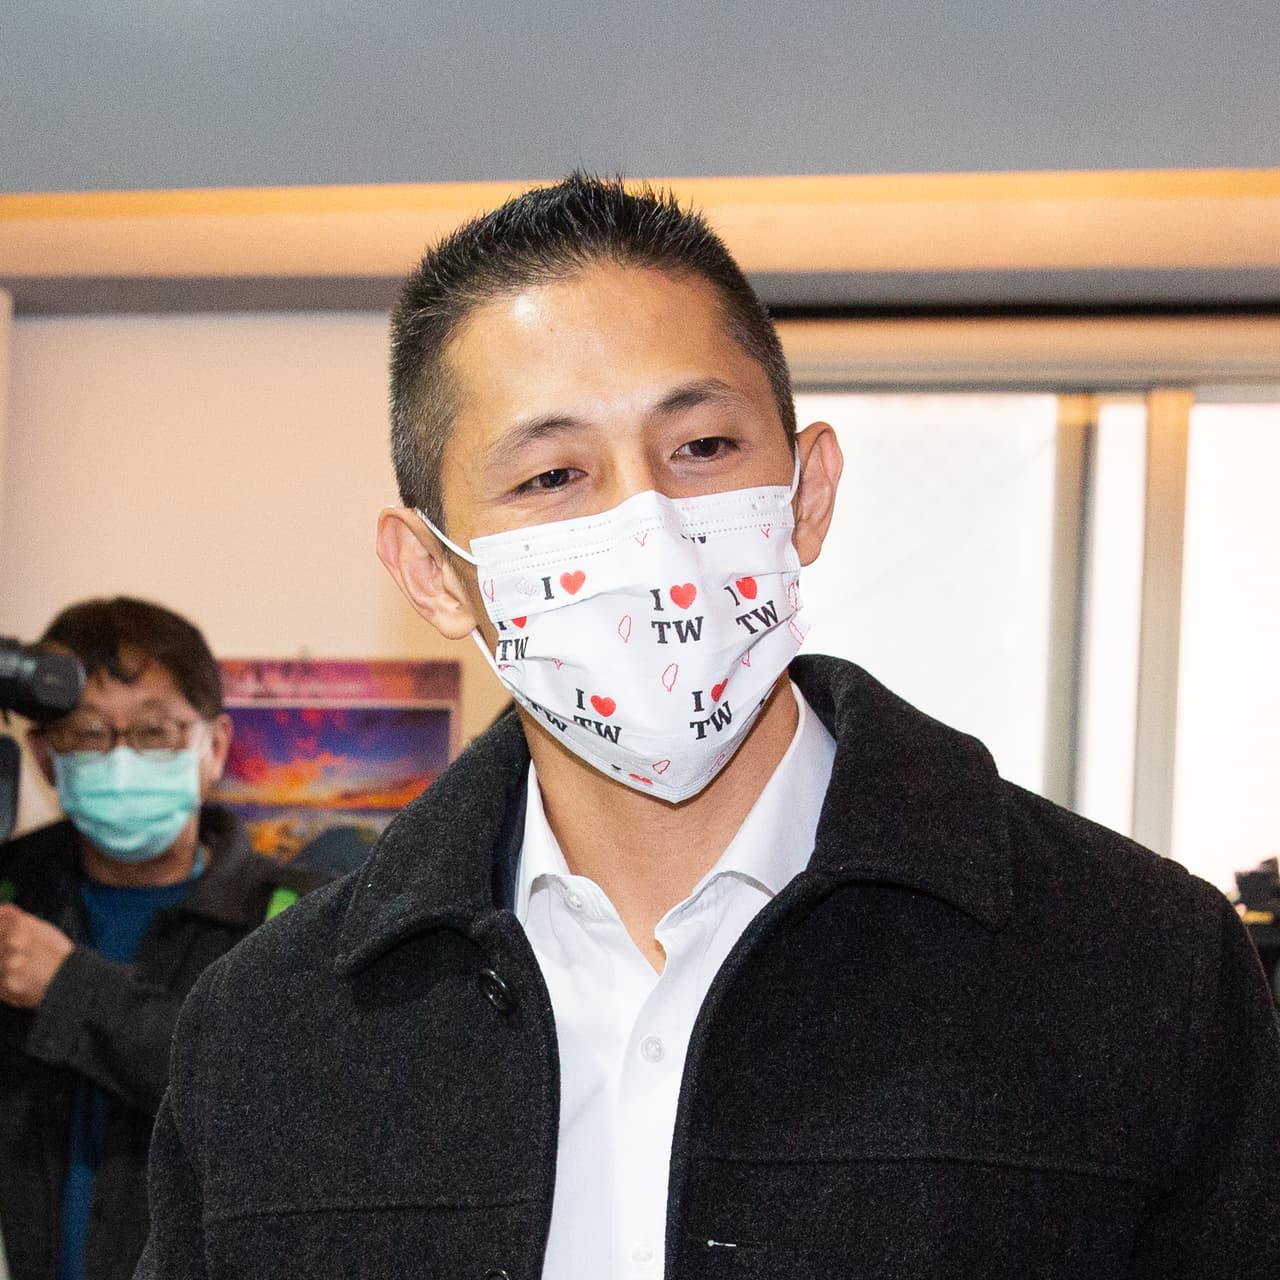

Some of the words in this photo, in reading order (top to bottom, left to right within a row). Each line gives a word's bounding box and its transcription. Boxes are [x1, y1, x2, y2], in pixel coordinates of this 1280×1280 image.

[541, 576, 554, 600] I
[649, 588, 664, 611] I
[736, 600, 779, 635] TW
[651, 616, 704, 644] TW
[497, 636, 529, 661] TW
[575, 688, 586, 710] I
[691, 690, 705, 712] I
[689, 701, 733, 740] TW
